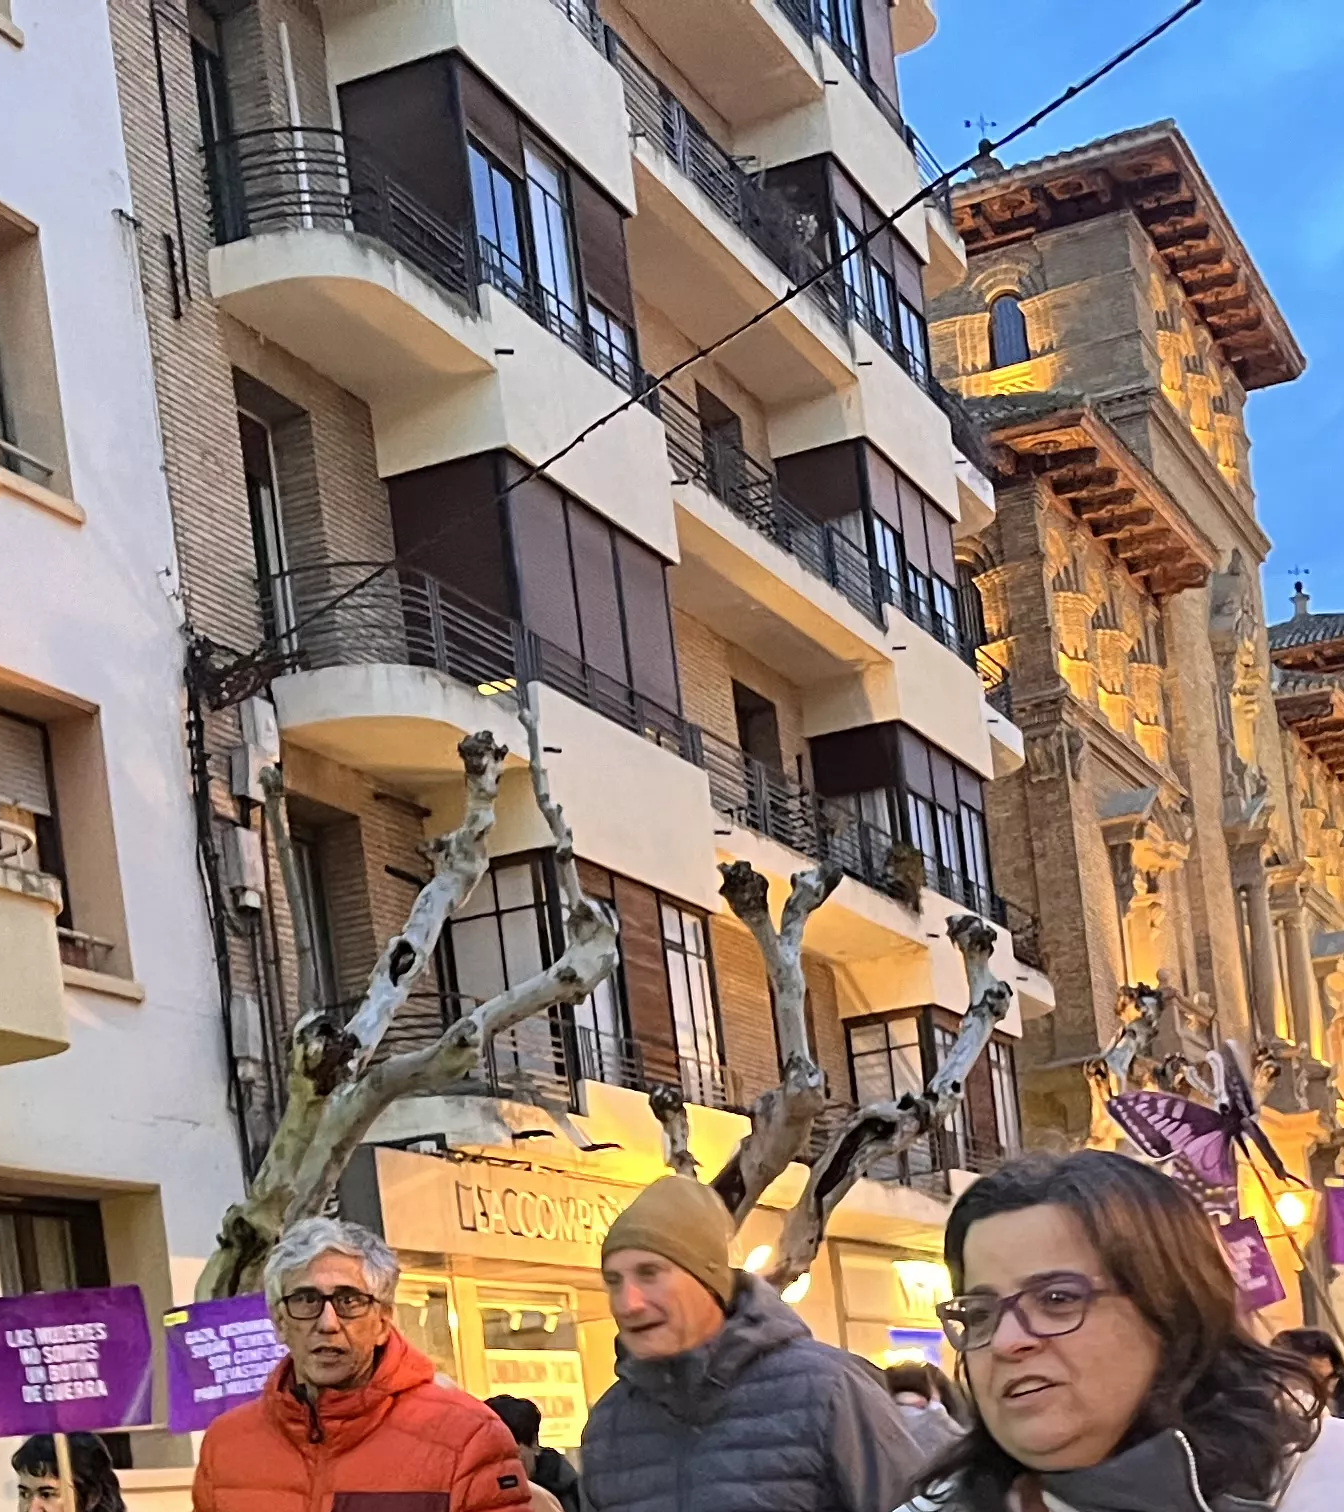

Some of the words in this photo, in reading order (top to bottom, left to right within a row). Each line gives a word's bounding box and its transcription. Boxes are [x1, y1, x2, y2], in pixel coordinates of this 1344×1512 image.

[5, 1328, 35, 1348] LAS
[34, 1322, 108, 1346] MUJERES
[19, 1347, 42, 1365] NO
[42, 1342, 100, 1364] SOMOS
[25, 1365, 47, 1384] UN
[22, 1384, 43, 1403] DE
[44, 1379, 108, 1402] GUERRA
